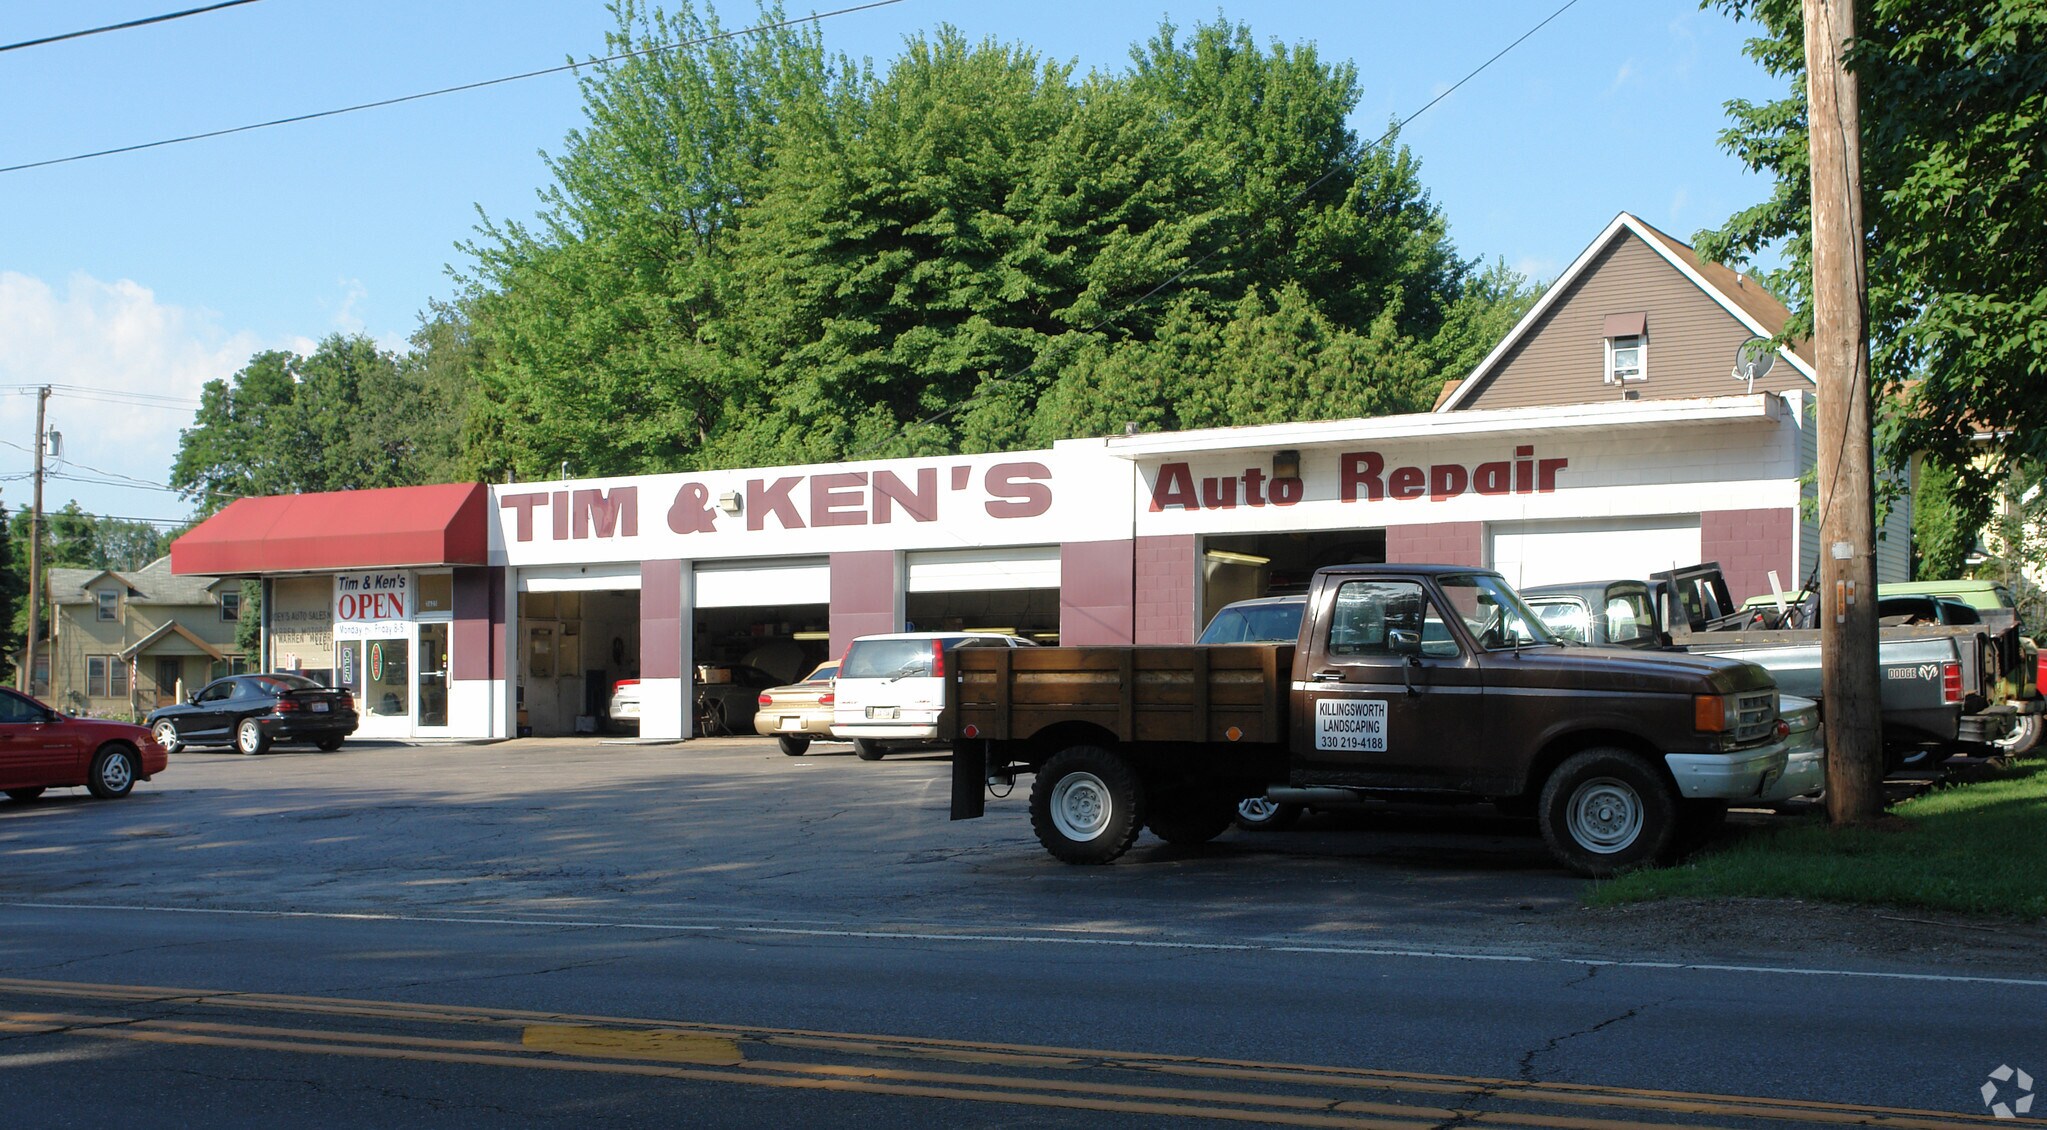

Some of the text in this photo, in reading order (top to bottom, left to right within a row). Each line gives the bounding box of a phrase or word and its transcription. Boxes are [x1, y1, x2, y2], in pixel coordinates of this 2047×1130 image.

[1148, 445, 1568, 513] Auto Repair
[501, 461, 1053, 542] TIM & KEN'S
[338, 574, 406, 590] Tim & Ken's
[338, 592, 405, 620] OPEN
[1888, 668, 1917, 679] DODGE
[1319, 703, 1385, 717] KILLINGSWORTH
[1323, 719, 1380, 733] LANDSCAPING
[1321, 736, 1383, 749] 330 219-4188
